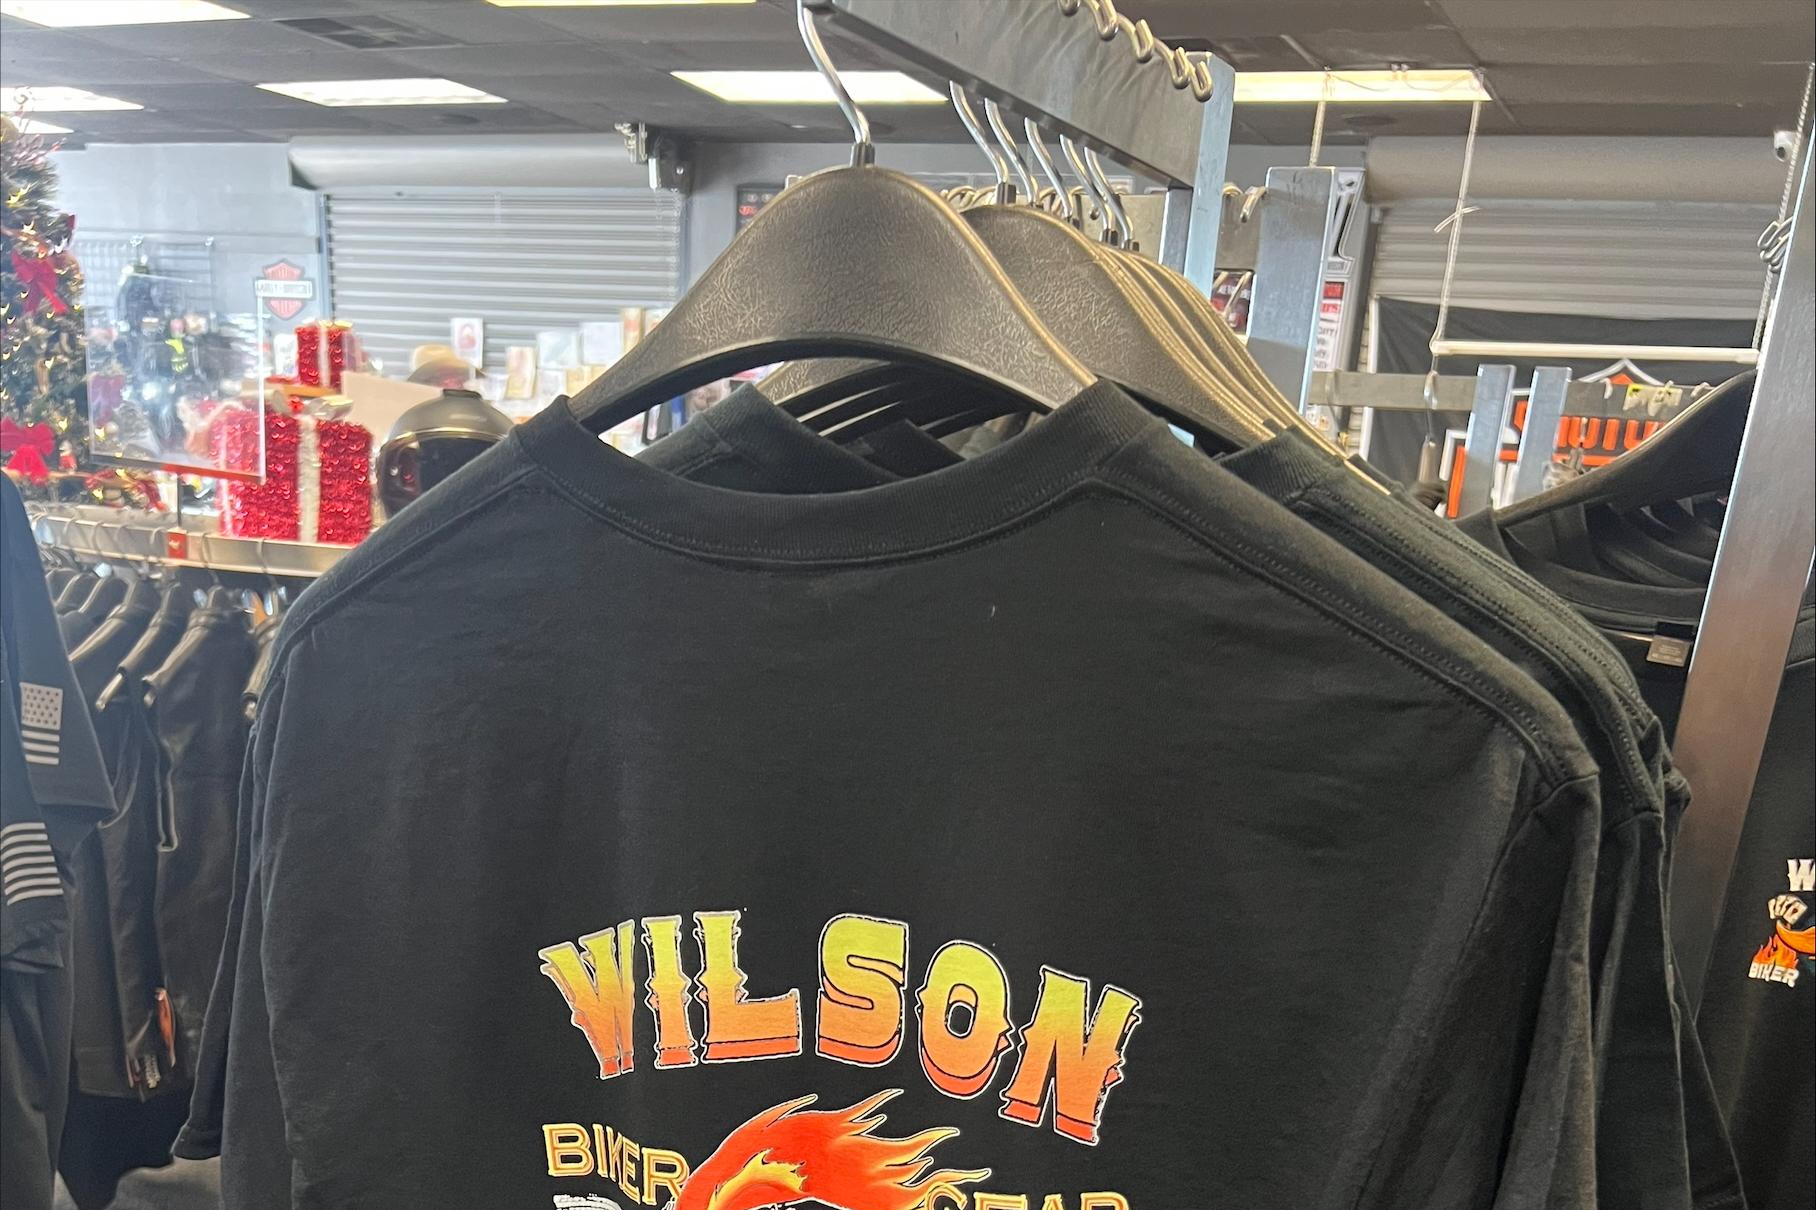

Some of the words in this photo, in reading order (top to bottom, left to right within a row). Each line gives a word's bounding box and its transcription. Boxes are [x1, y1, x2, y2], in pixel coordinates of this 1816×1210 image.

[1748, 963, 1800, 988] BIKER
[538, 911, 1143, 1146] WILSON
[542, 1123, 690, 1206] BIKER
